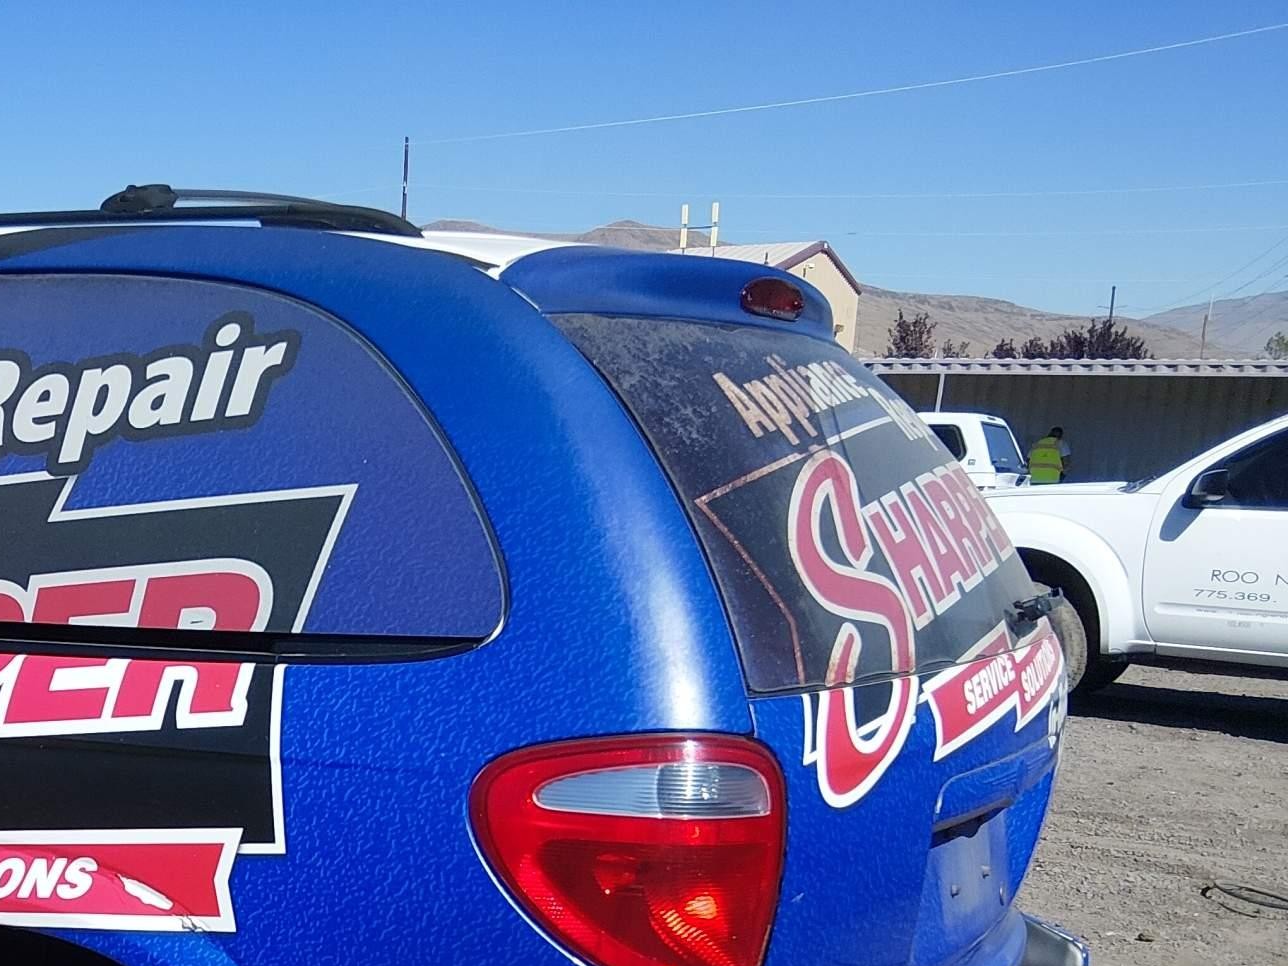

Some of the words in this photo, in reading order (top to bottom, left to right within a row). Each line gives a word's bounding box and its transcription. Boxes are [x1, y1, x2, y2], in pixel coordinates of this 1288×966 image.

[712, 353, 869, 446] Appliance
[1211, 569, 1259, 584] ROO
[963, 648, 1016, 714] SERVICE
